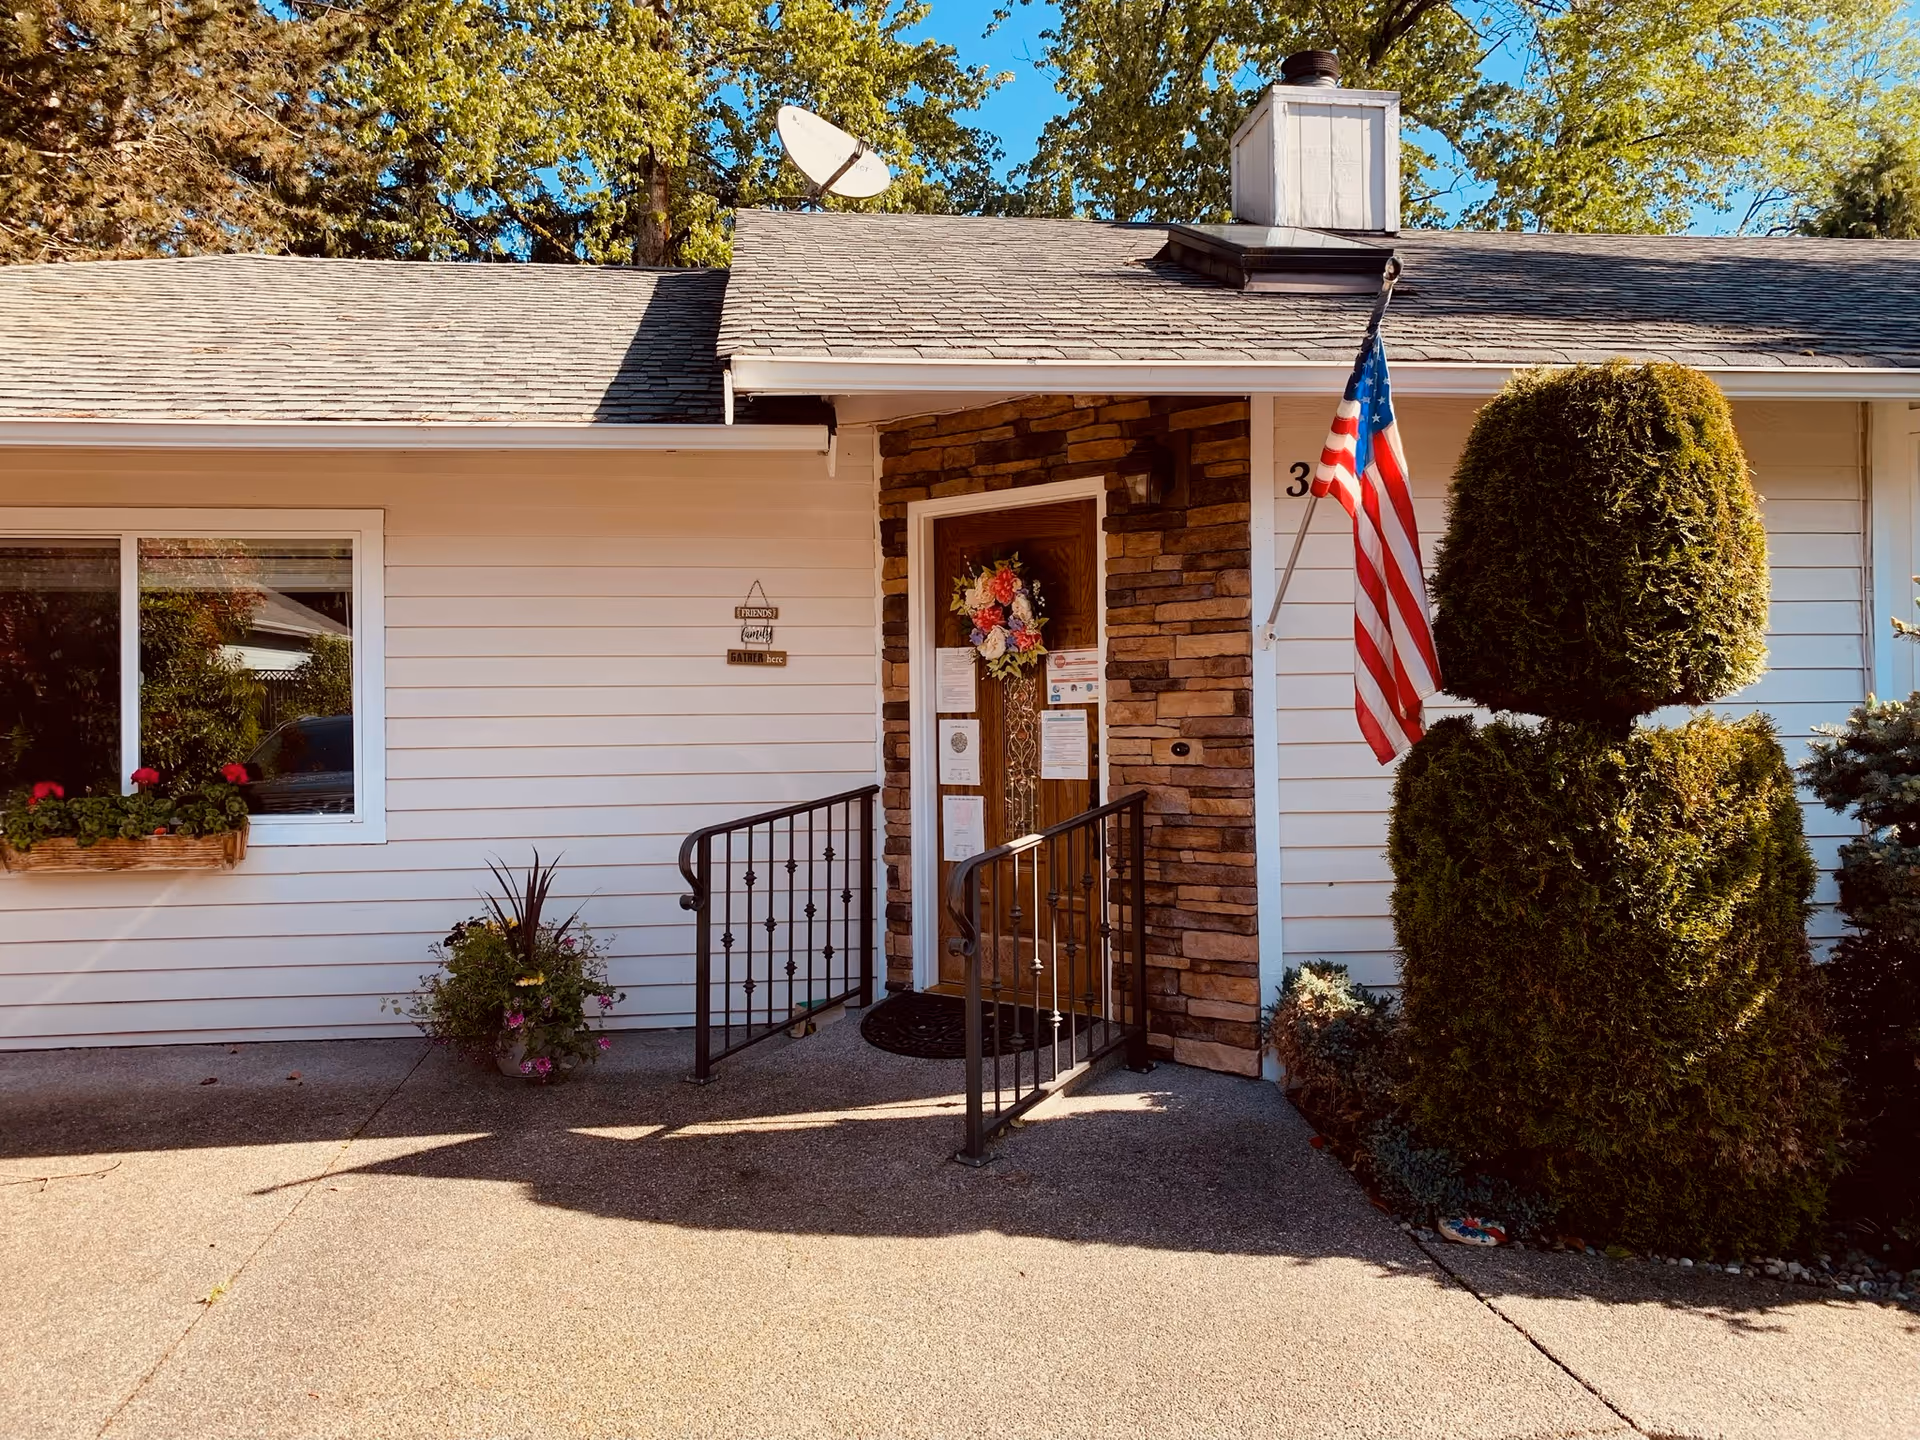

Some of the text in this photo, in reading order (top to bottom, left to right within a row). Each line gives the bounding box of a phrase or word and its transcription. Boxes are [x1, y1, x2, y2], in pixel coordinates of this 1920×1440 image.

[1286, 461, 1310, 497] 3
[741, 608, 772, 618] FRIENDS
[730, 652, 784, 664] GATHER here
